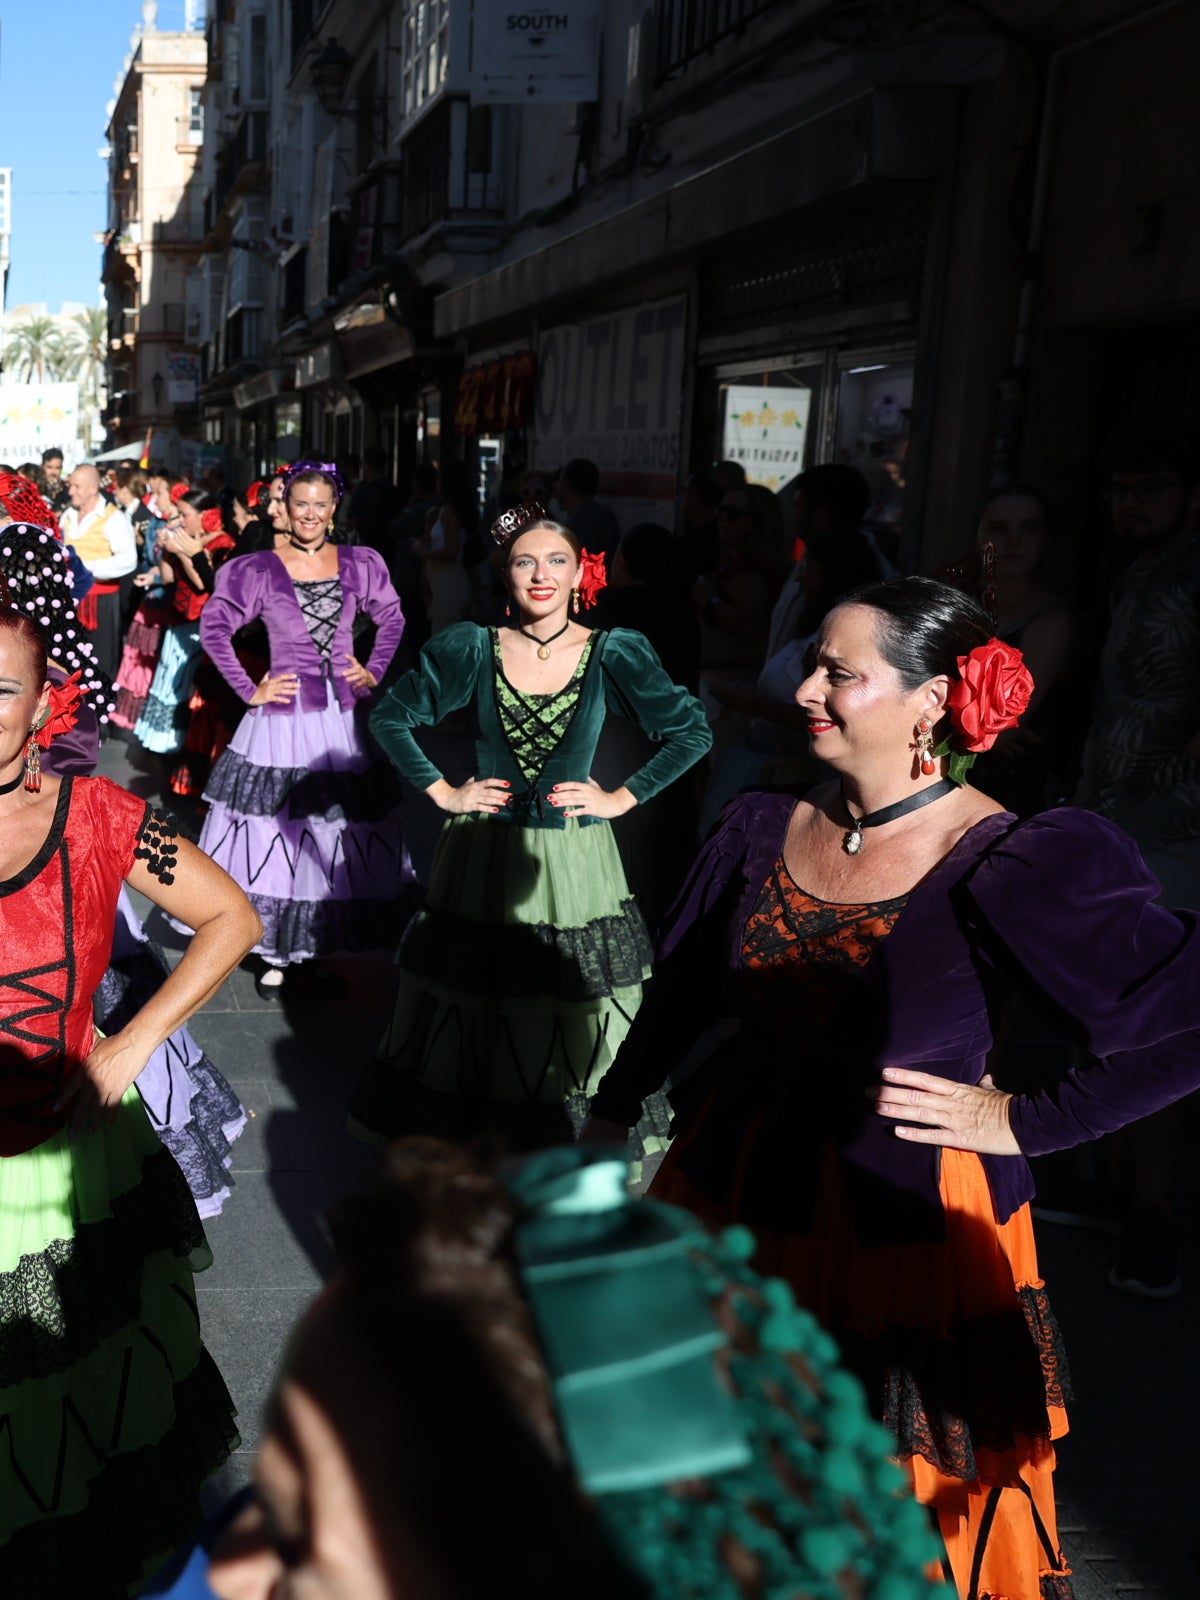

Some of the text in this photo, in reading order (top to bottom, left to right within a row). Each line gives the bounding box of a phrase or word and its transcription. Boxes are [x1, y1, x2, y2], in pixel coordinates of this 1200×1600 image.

[507, 14, 568, 30] SOUTH
[535, 301, 684, 435] OUTLET
[3, 443, 71, 457] ARGENA
[620, 432, 678, 470] ZAPATOS
